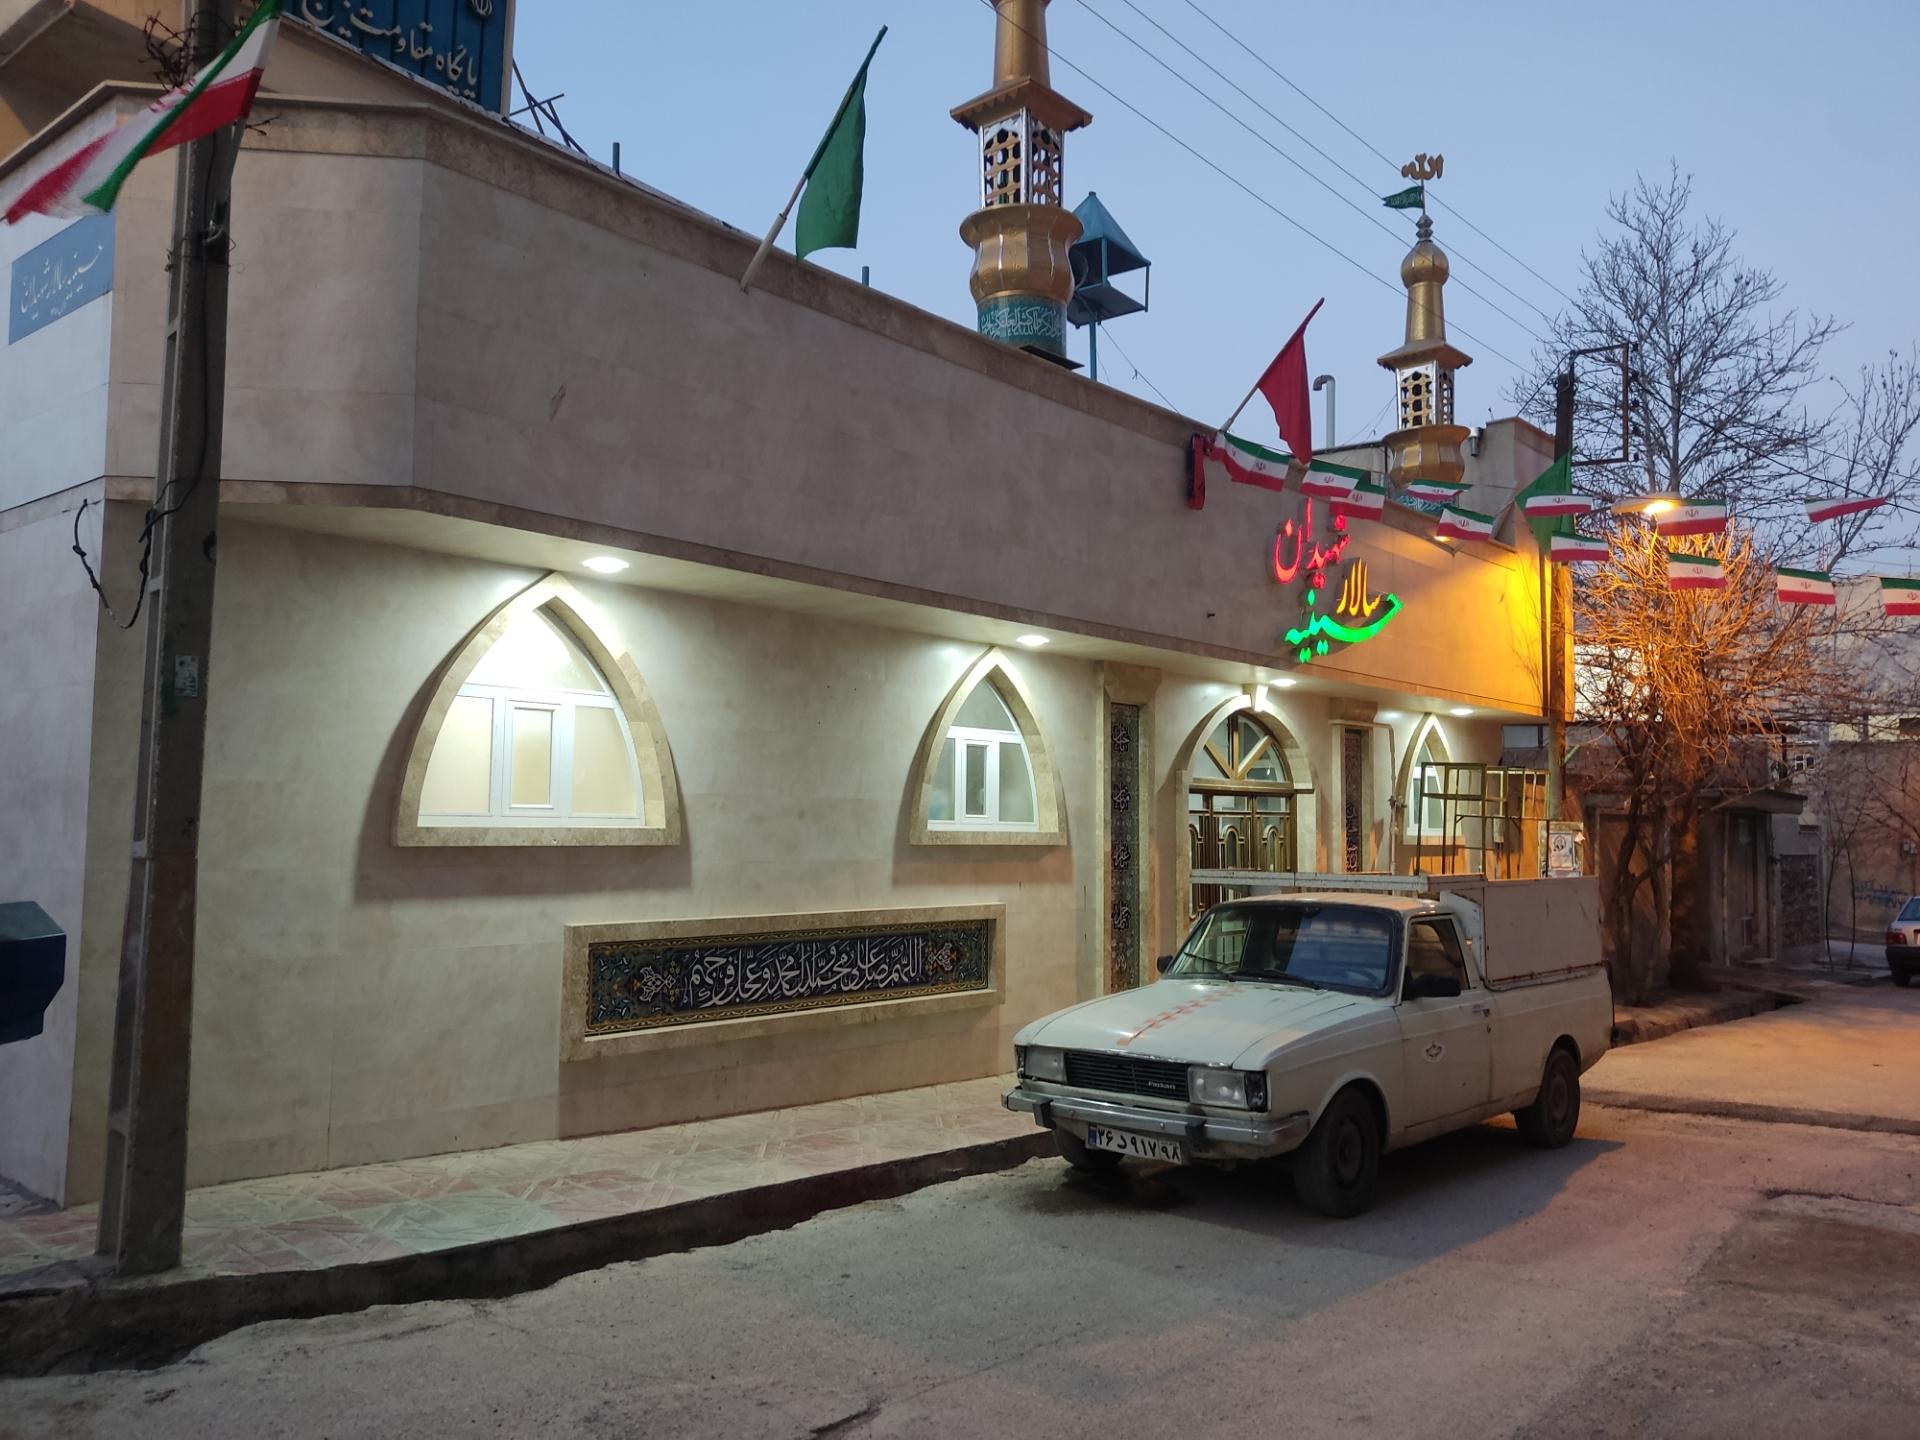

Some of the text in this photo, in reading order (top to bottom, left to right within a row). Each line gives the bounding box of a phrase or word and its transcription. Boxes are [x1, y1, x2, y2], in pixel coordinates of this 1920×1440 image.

[351, 7, 433, 59] مقاومت
[1401, 153, 1444, 180] الله
[1274, 496, 1403, 664] حسینیه سالار شهیدان
